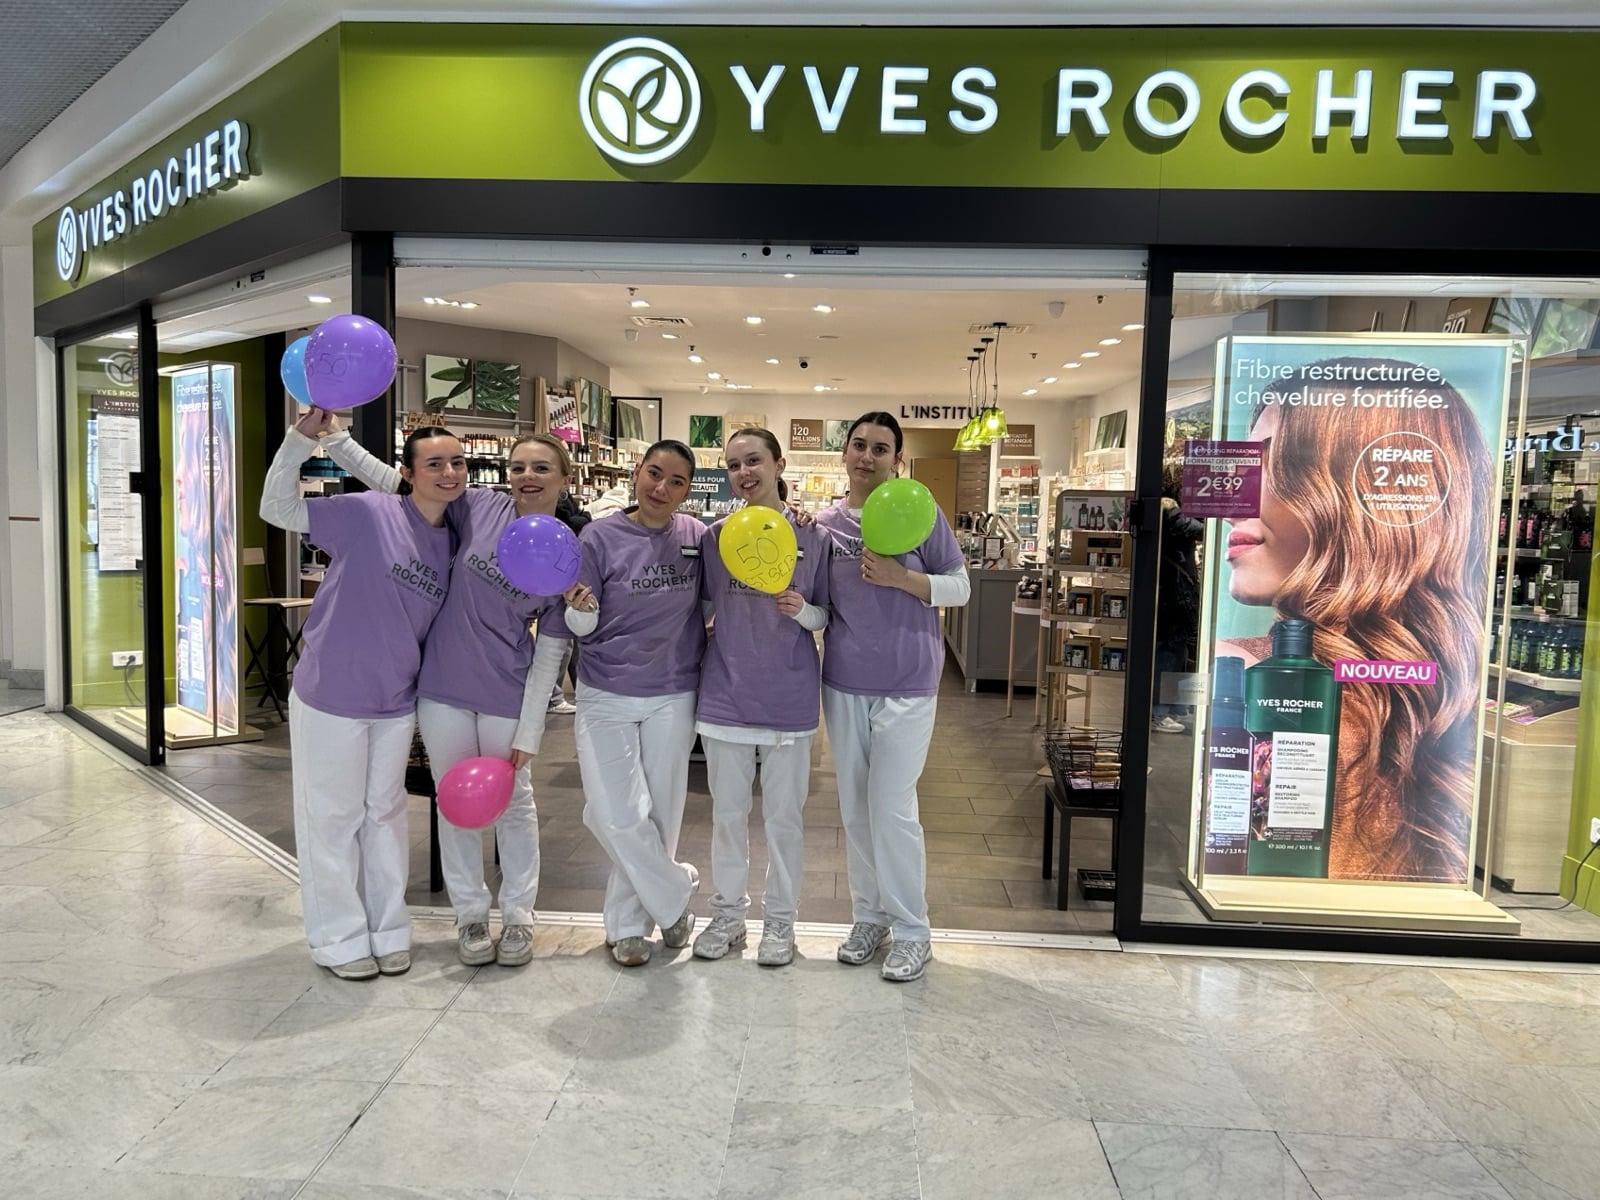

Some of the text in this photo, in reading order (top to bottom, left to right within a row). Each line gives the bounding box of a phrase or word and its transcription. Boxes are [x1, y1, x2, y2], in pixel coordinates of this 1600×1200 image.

[730, 65, 1538, 141] YVES ROCHER
[79, 119, 242, 252] YVES ROCHER
[1236, 358, 1447, 385] Fibre restructurée,
[1235, 384, 1449, 410] chevelure fortifiée.
[792, 426, 809, 436] 120
[792, 435, 821, 443] MILLIONS
[1372, 446, 1433, 462] RÉPARE
[1196, 476, 1243, 497] 2€99
[1373, 466, 1428, 487] 2 ANS
[1363, 493, 1423, 502] D'AGRESSIONS
[736, 537, 780, 572] 50
[409, 556, 439, 582] YVES
[643, 564, 676, 576] YVES
[1340, 662, 1432, 681] NOUVEAU
[1257, 698, 1324, 709] YVES ROCHER
